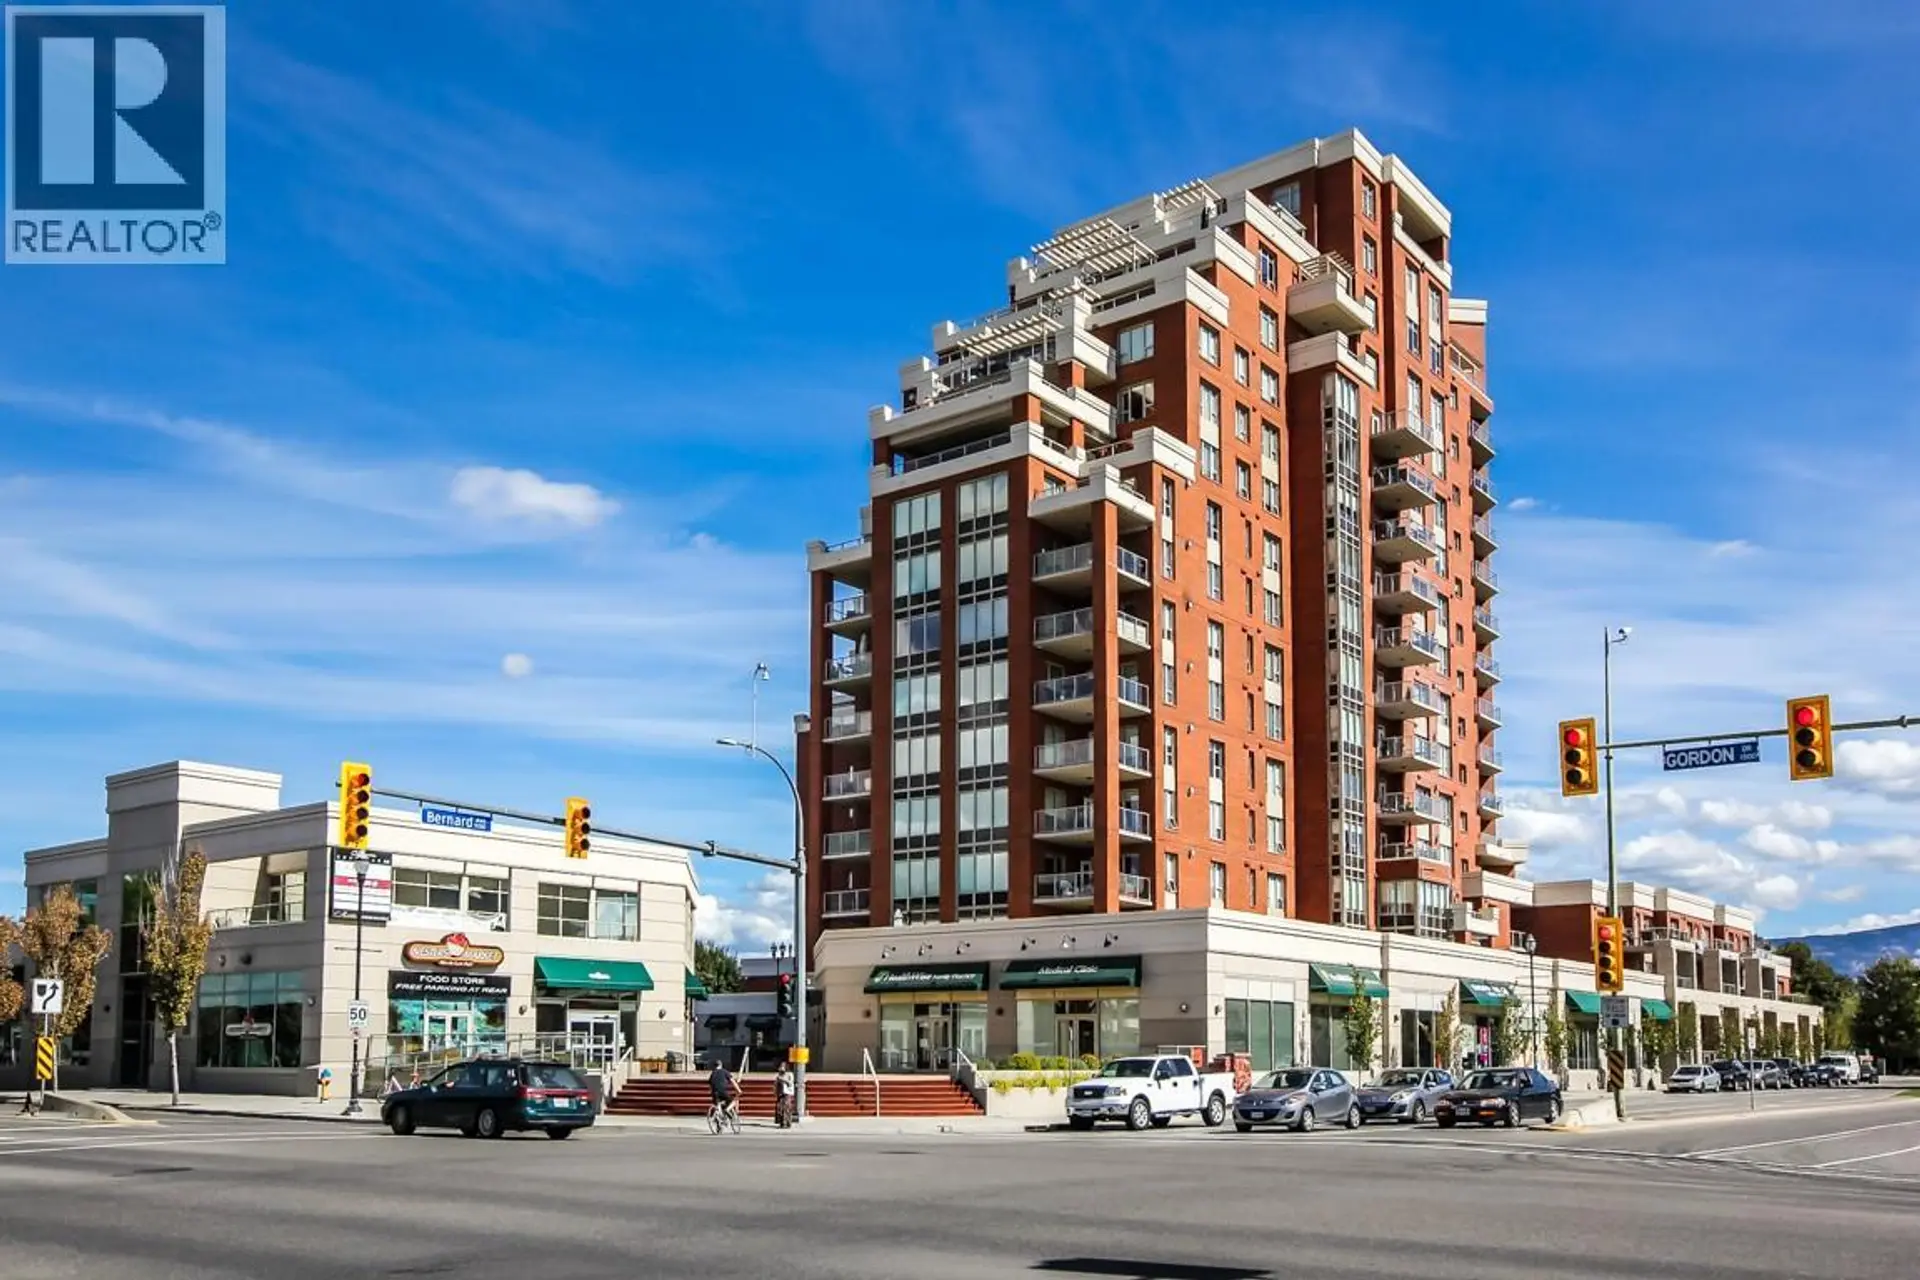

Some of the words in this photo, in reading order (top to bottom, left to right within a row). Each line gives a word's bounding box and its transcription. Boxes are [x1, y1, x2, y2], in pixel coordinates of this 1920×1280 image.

[1667, 747, 1735, 768] GORDON
[426, 811, 473, 828] Bernard
[419, 975, 450, 984] FOOD
[451, 976, 486, 985] STORE
[424, 984, 468, 993] PARKING
[350, 1007, 367, 1021] 50
